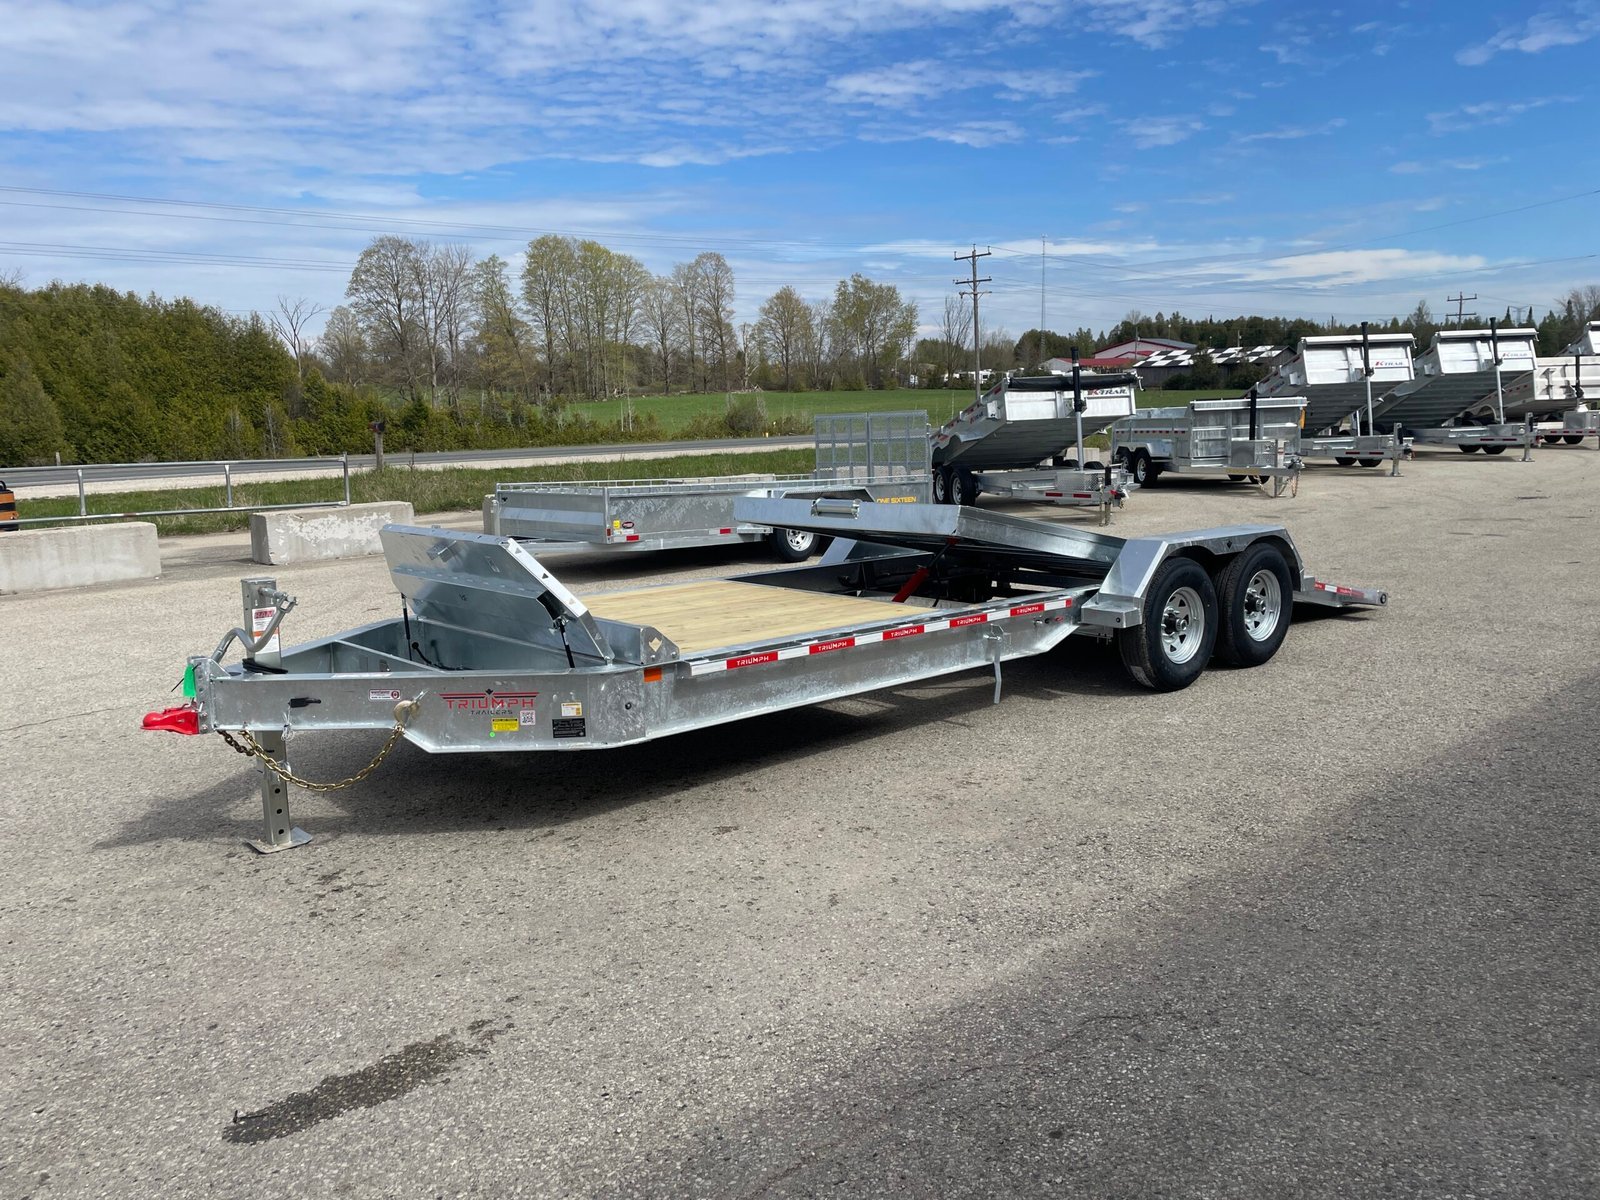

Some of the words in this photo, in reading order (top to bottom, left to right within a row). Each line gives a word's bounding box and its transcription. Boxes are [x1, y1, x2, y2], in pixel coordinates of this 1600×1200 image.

[890, 496, 917, 504] SIXTEEN
[1016, 605, 1039, 614] TRIUMPH
[956, 616, 981, 625] TRIUMPH
[890, 628, 918, 638] TRIUMPH
[818, 641, 847, 652] TRIUMPH
[736, 655, 769, 666] TRIUMPH
[446, 698, 534, 710] TRIUMPH
